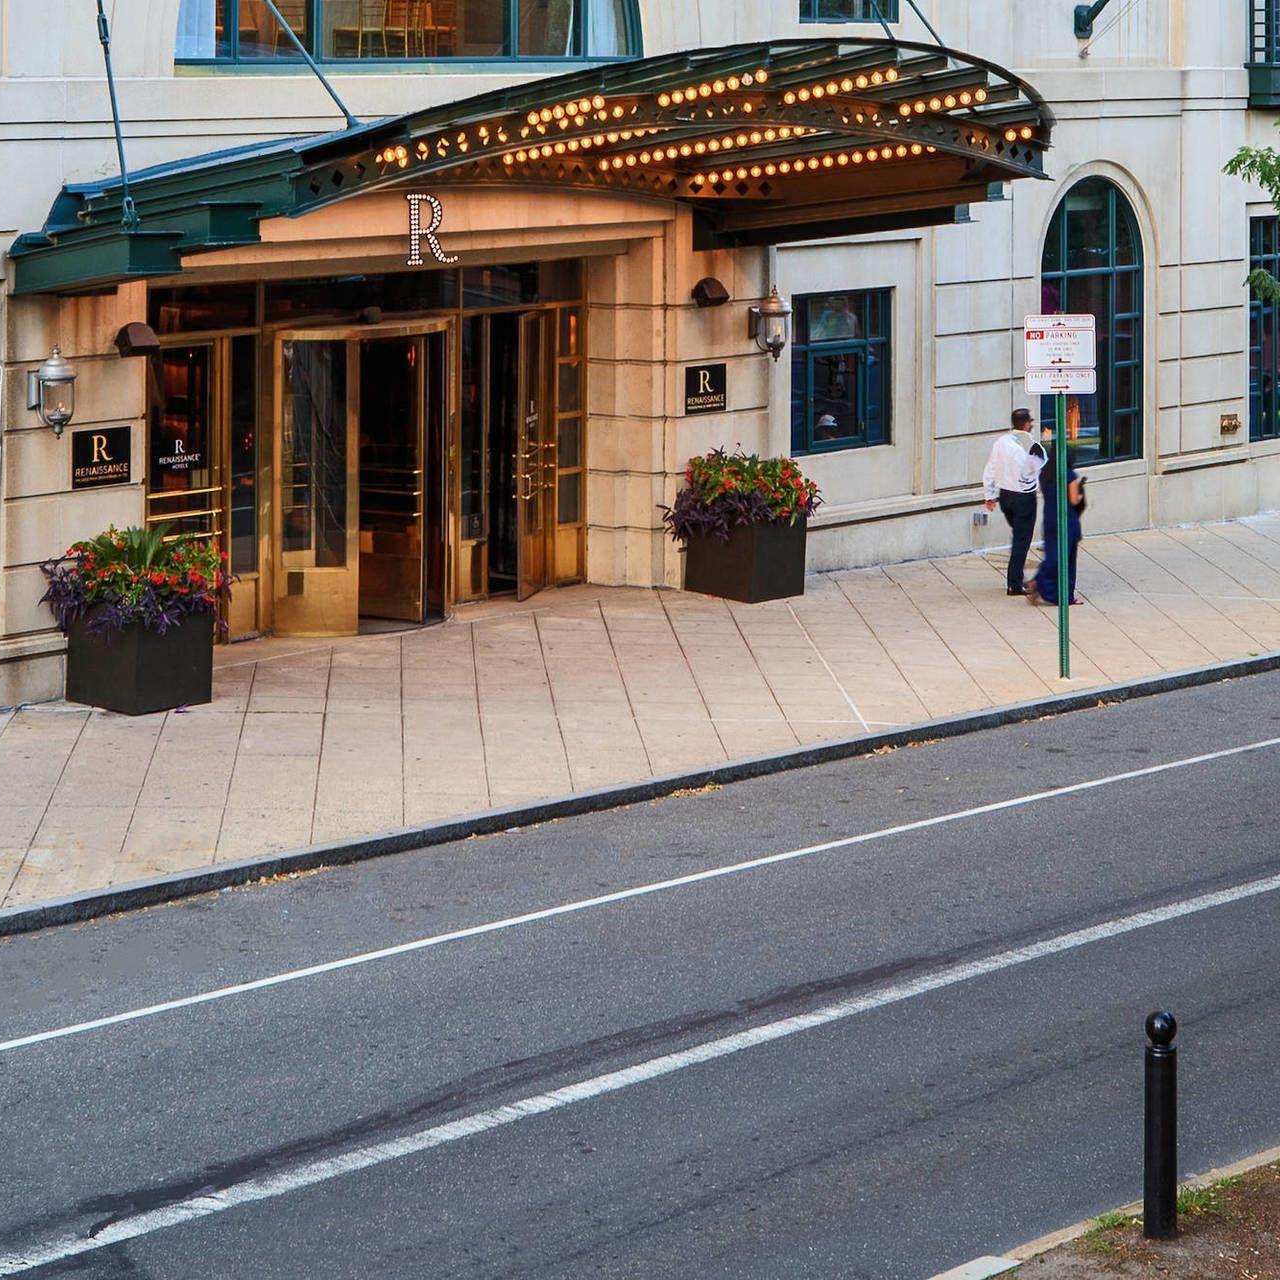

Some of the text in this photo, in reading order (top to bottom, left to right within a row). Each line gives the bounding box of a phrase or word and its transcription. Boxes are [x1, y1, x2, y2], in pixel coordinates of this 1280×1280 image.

[406, 193, 460, 267] R
[1029, 331, 1078, 340] NO PARKING
[698, 370, 714, 393] R
[687, 393, 725, 405] RENAISSANCE
[91, 434, 113, 463] R
[175, 439, 186, 454] R
[158, 453, 201, 465] RENAISSANCE
[74, 462, 129, 477] RENAISSANCE
